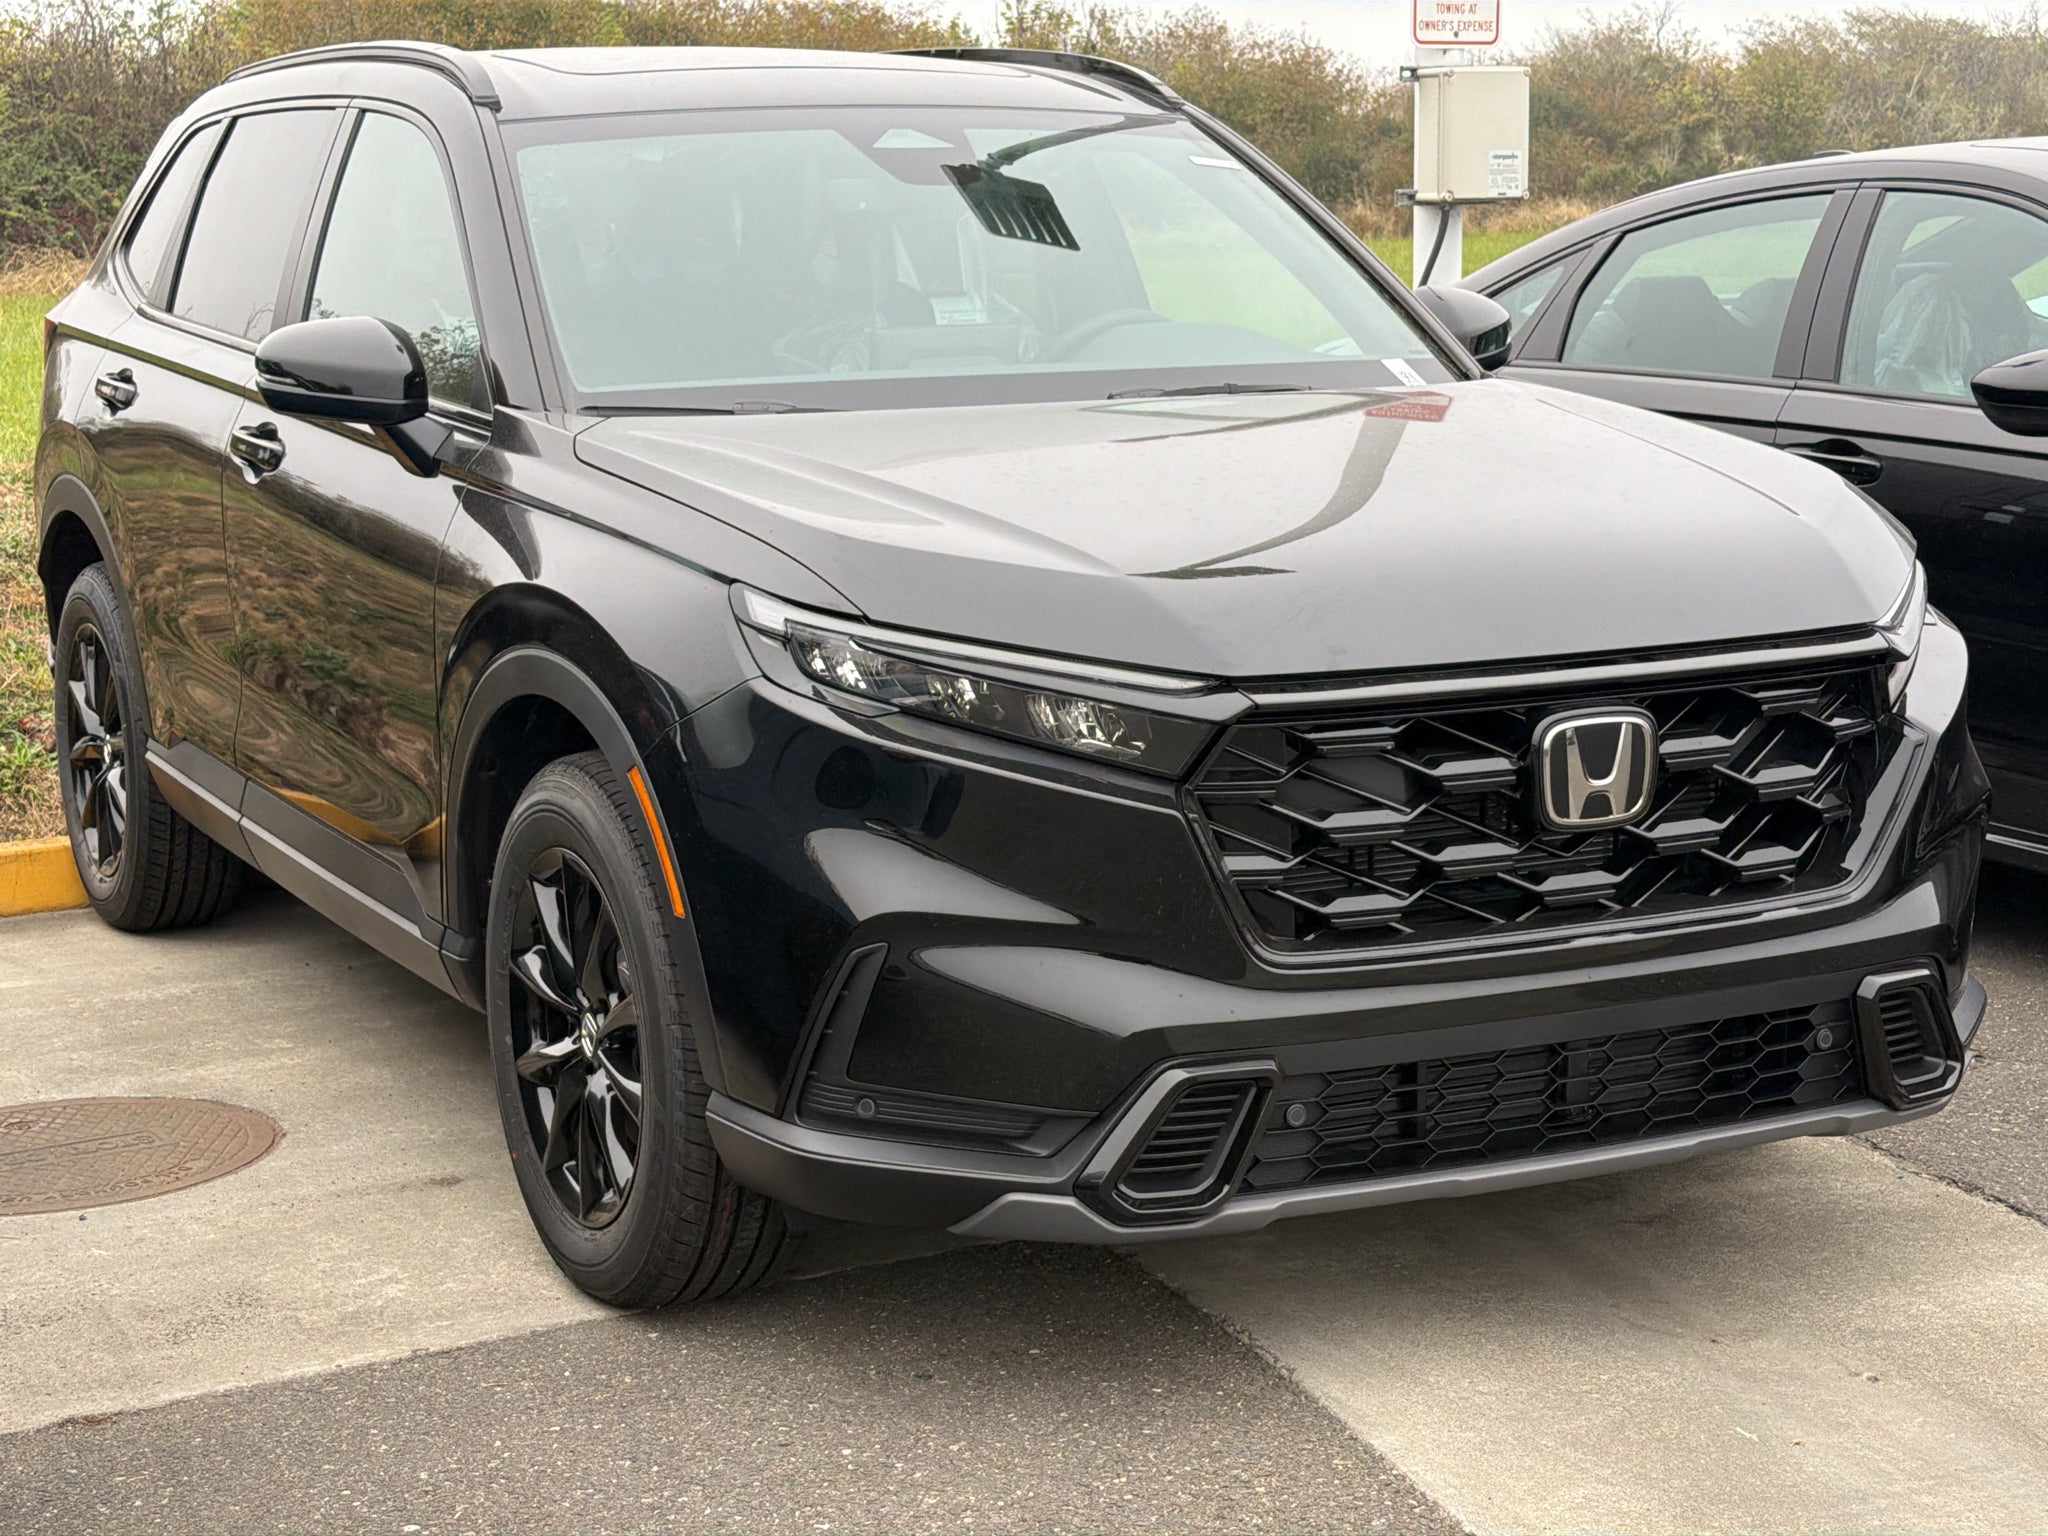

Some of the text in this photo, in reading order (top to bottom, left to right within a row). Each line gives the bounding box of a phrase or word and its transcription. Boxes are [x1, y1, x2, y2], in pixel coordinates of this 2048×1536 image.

[1436, 3, 1478, 15] TOWING AT
[1418, 20, 1494, 32] OWNER'S EXPENSE
